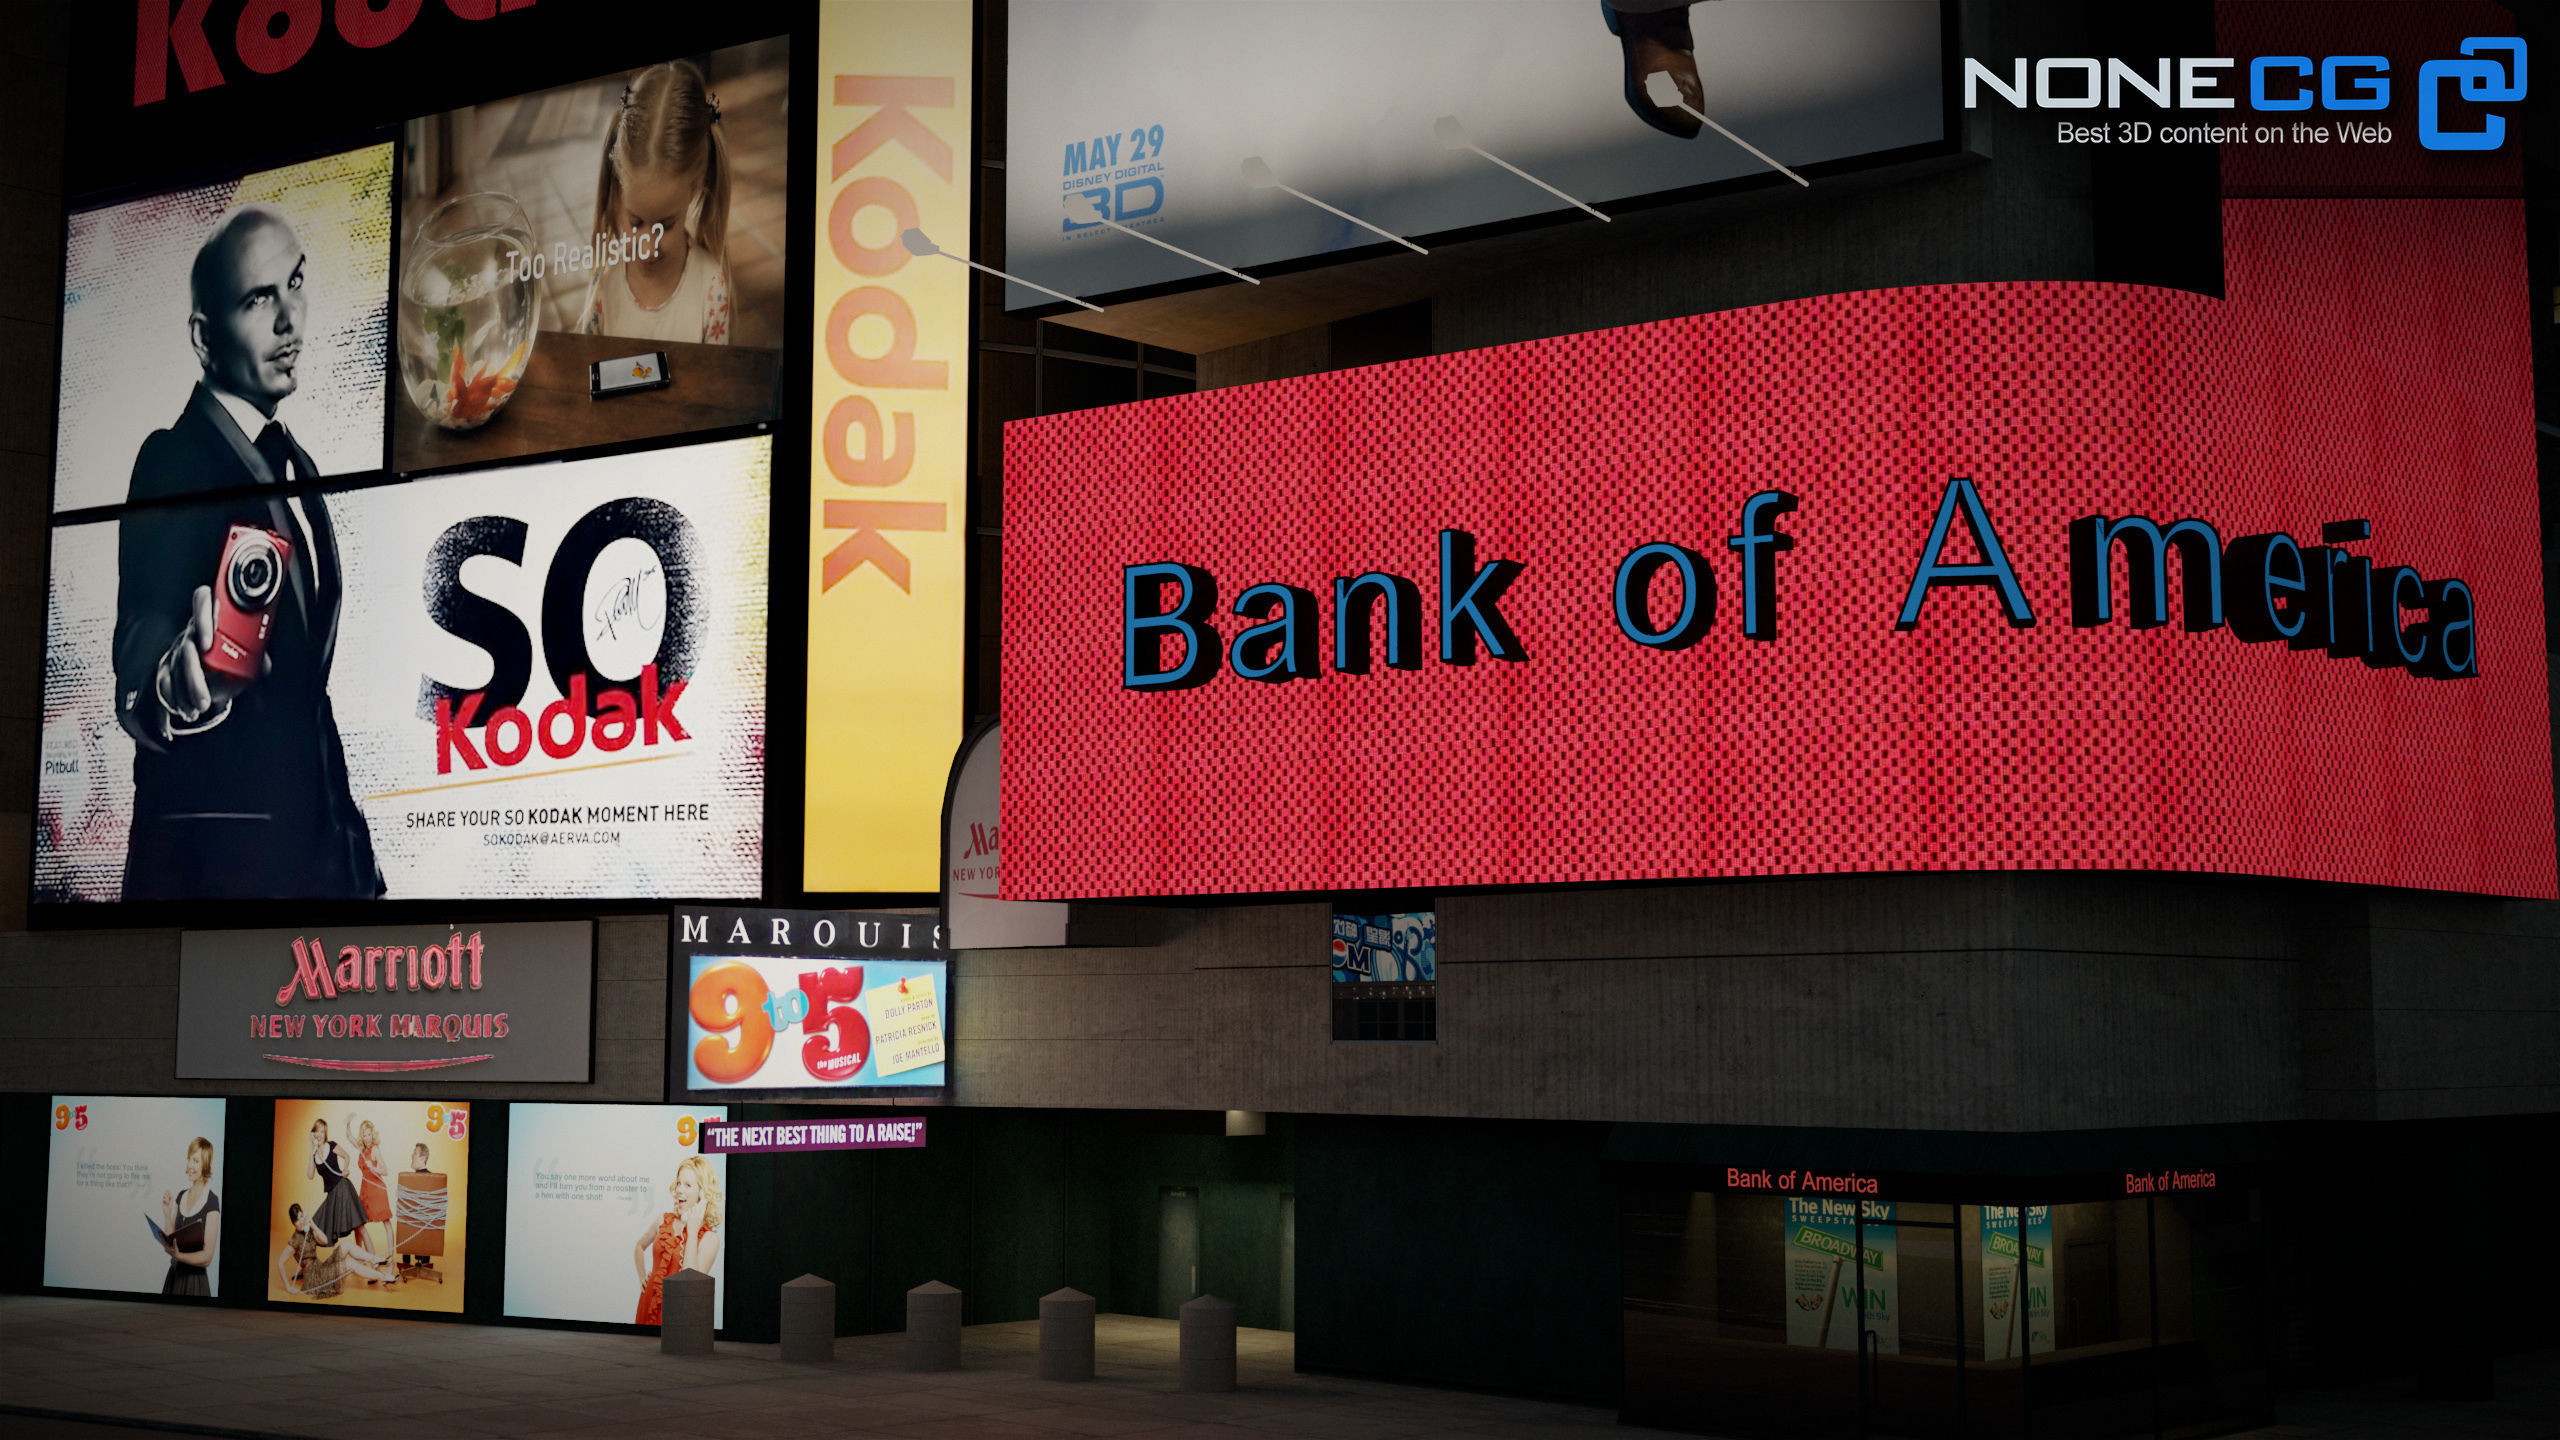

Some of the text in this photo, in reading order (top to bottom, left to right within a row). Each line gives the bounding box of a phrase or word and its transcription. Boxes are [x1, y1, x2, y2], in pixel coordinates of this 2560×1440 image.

[1063, 123, 1165, 177] MAY 29
[1063, 162, 1165, 191] DISNEY DIGITAL
[506, 222, 665, 284] Too Realistic?
[822, 75, 955, 596] Kodak
[1123, 477, 2480, 692] Bank of America
[415, 496, 711, 729] SO
[434, 662, 693, 776] Kodak
[45, 760, 80, 775] Pitbull
[406, 804, 709, 828] SHARE YOUR SO KODAK MOMENT HERE
[953, 868, 976, 881] NEW
[275, 929, 485, 1006] Marriott
[885, 1005, 905, 1019] DOLLY
[907, 998, 934, 1013] PARTON
[250, 1013, 510, 1042] NEW YORK MARQUIS
[689, 961, 871, 1084] 9 to 5
[875, 1028, 907, 1045] PATRICIA
[908, 1021, 937, 1036] RESNICK
[816, 1052, 862, 1071] the MUSICAL
[905, 1043, 940, 1060] MANTELLO
[425, 1103, 444, 1133] 9
[448, 1110, 467, 1140] 5
[677, 1115, 698, 1147] 9
[741, 1126, 774, 1147] NEXT
[776, 1125, 808, 1146] BEST
[809, 1124, 847, 1145] THING
[848, 1124, 864, 1143] TO
[866, 1124, 876, 1143] A
[536, 1172, 549, 1180] You
[550, 1173, 562, 1182] say
[1727, 1168, 1879, 1193] Bank of America
[2126, 1169, 2216, 1194] Bank of America
[1788, 1197, 1890, 1220] The New Sky
[1841, 1286, 1886, 1311] WIN
